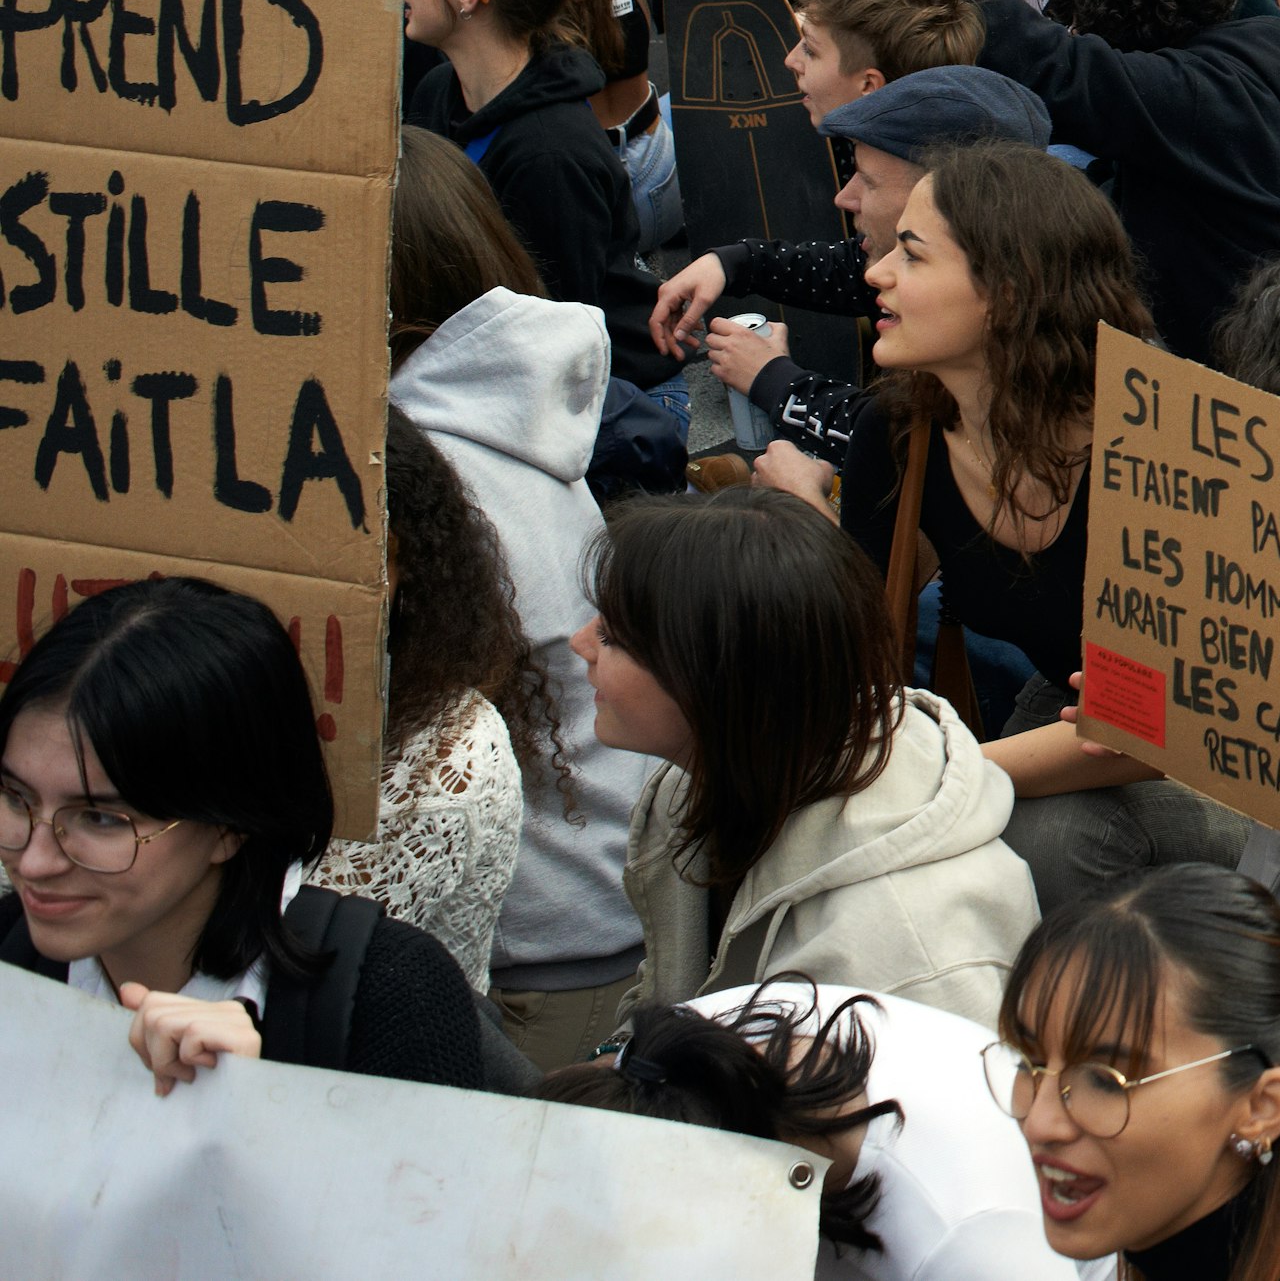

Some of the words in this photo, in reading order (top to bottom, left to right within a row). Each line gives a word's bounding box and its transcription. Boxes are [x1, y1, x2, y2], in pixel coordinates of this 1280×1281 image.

[1190, 393, 1275, 483] LES
[1122, 526, 1183, 588] LES
[1172, 658, 1240, 721] LES
